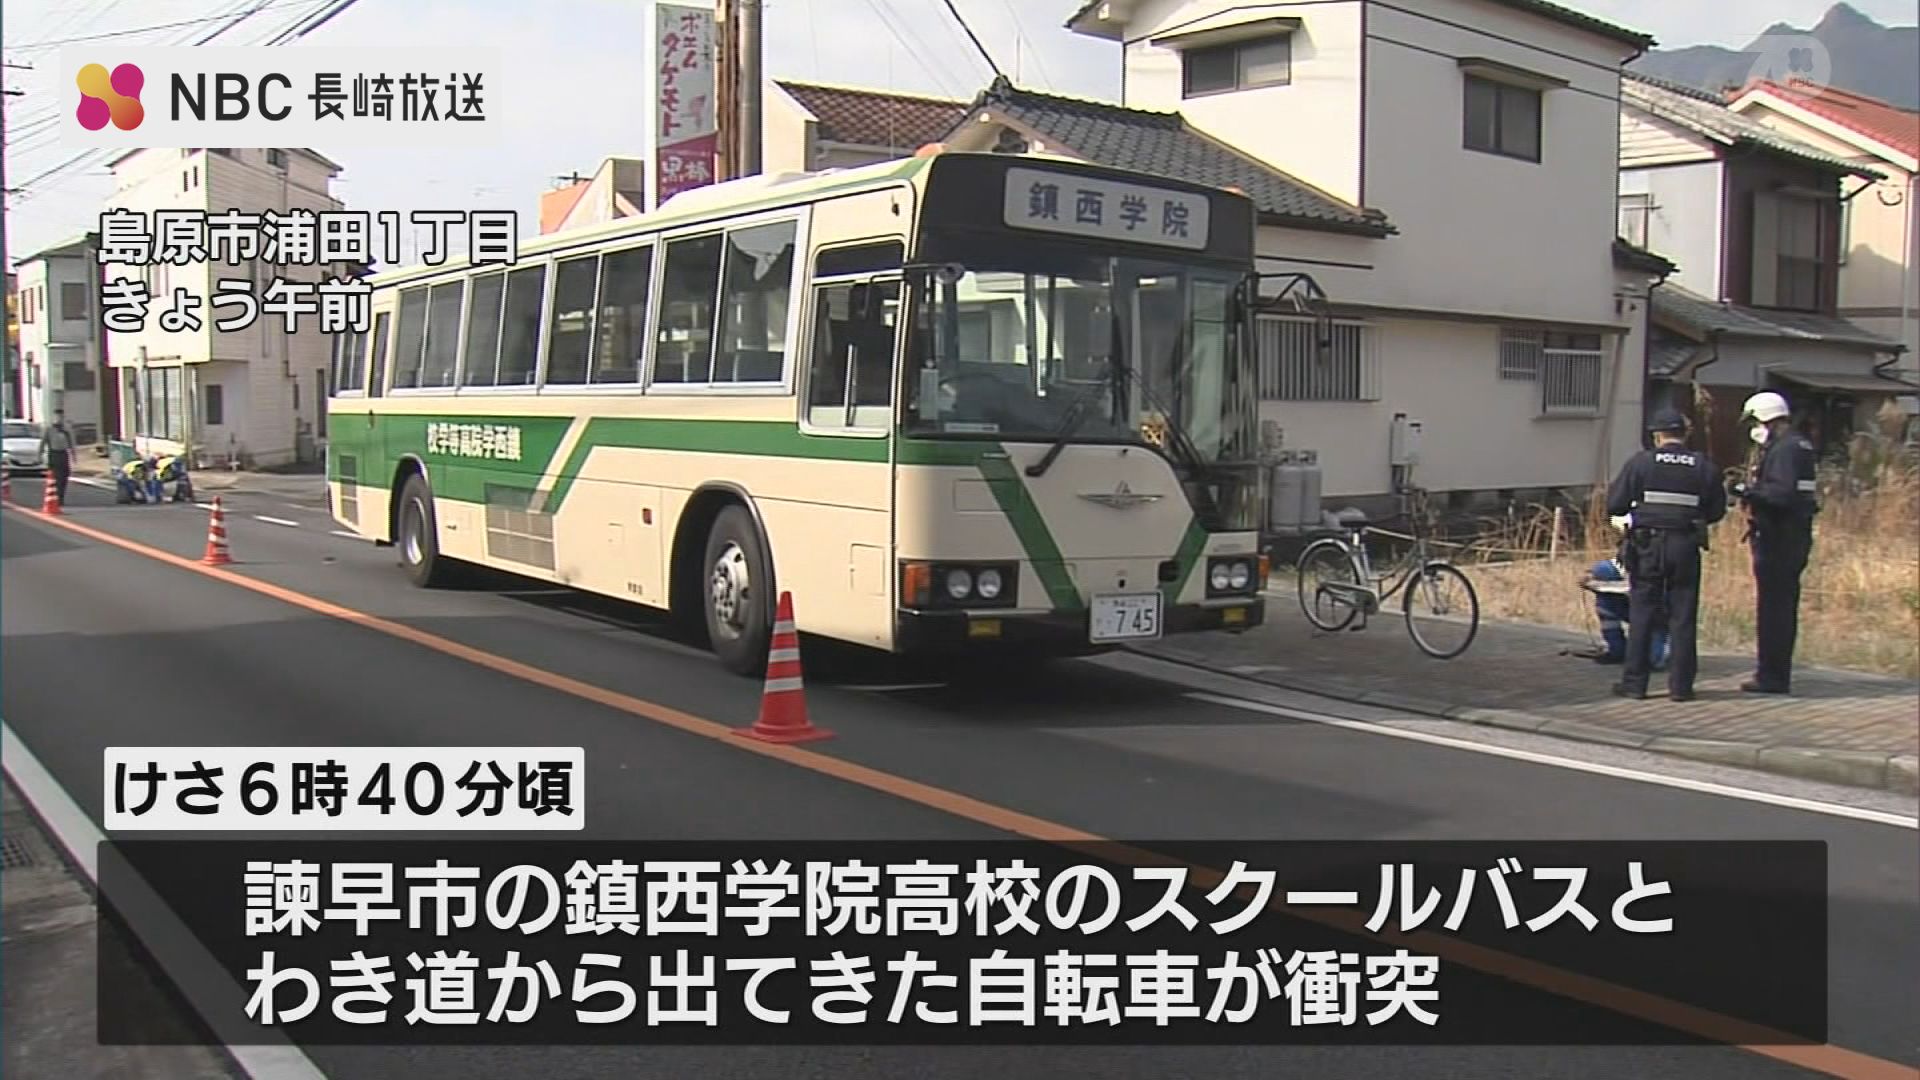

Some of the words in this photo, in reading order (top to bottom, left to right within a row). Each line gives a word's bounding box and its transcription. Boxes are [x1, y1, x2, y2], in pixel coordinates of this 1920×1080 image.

[660, 31, 681, 138] タケモト
[1027, 181, 1189, 238] 鎮西学院
[1655, 452, 1696, 466] POLICE
